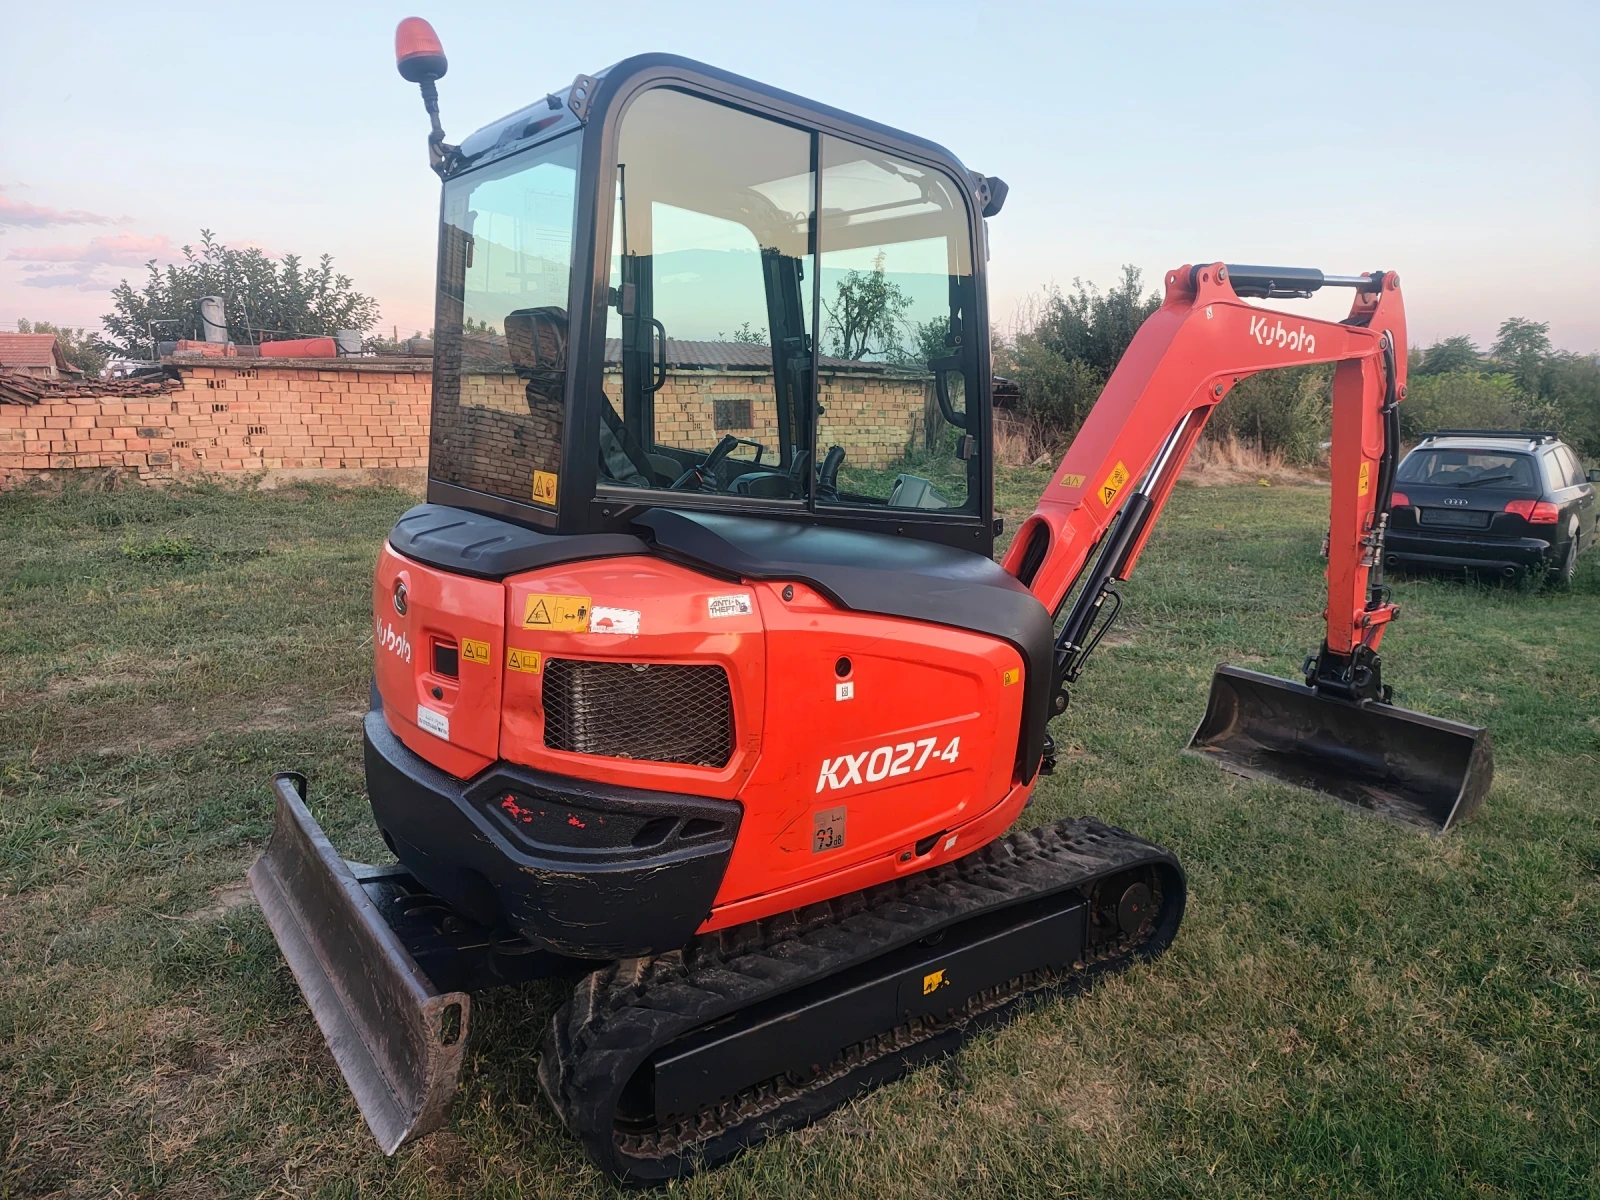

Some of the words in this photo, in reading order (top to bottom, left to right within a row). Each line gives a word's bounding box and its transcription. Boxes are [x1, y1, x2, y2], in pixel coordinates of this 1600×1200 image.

[1249, 315, 1316, 354] Kubota
[710, 605, 735, 614] THEFT
[376, 614, 411, 664] Kubota
[815, 736, 961, 793] KX027-4
[833, 834, 842, 846] dB
